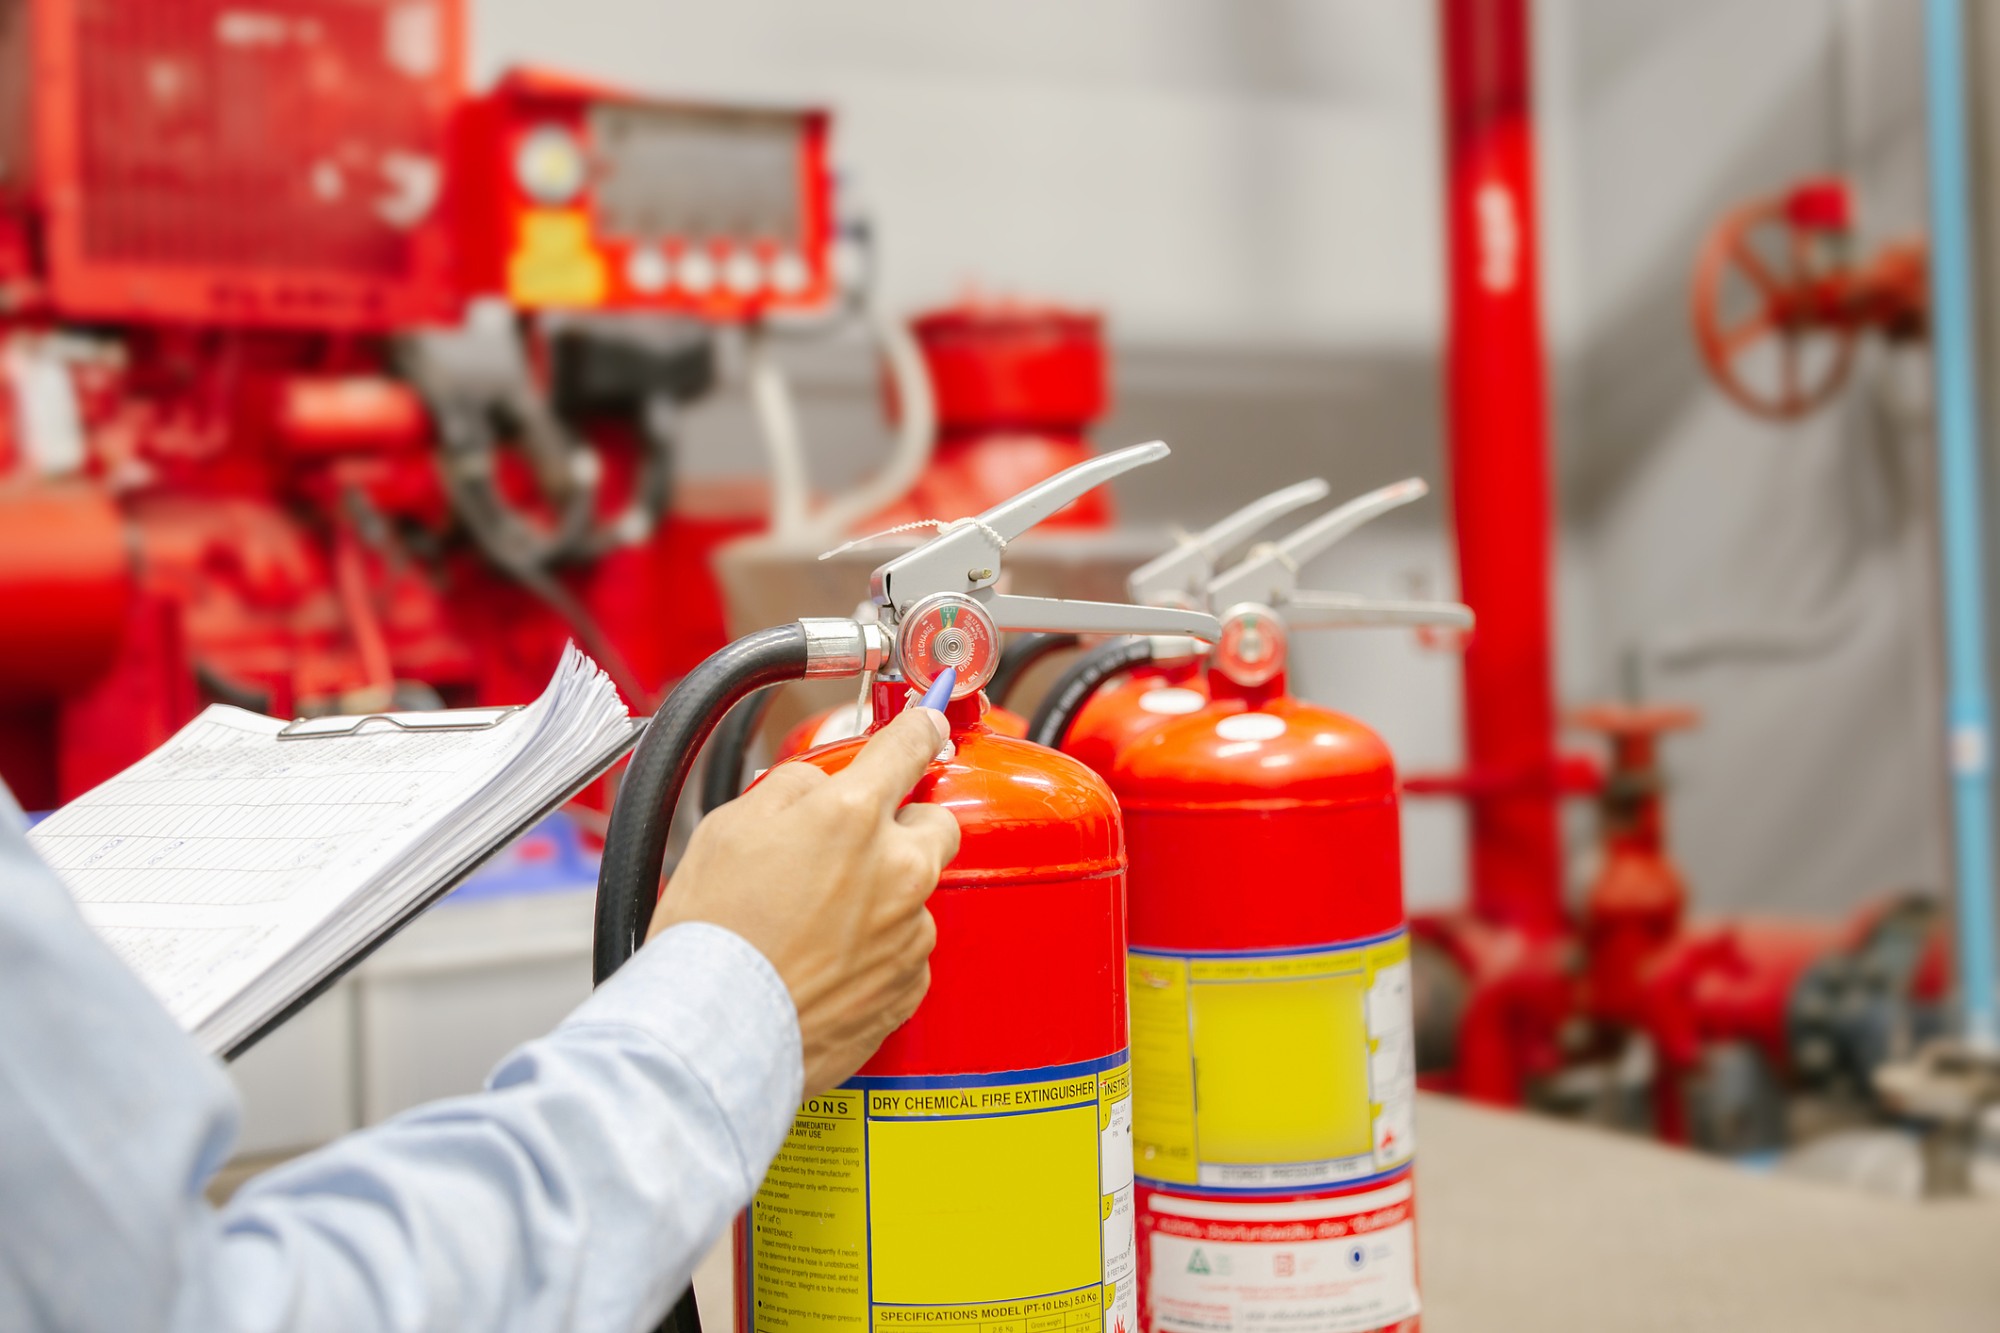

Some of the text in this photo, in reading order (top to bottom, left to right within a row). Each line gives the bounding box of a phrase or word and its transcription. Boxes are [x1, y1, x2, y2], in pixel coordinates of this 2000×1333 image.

[918, 623, 936, 656] RECHARGE
[873, 1081, 1094, 1110] DRY CHEMICAL FIRE EXTINGUISHER
[796, 1120, 836, 1131] IMMEDIATELY
[796, 1129, 807, 1138] ANY
[808, 1130, 822, 1138] USE
[826, 1146, 858, 1154] organization
[842, 1158, 860, 1167] Using
[800, 1168, 806, 1176] by
[806, 1182, 816, 1192] only
[794, 1208, 822, 1218] temperature
[762, 1226, 793, 1238] MAINTENANCE
[811, 1246, 835, 1256] frequently
[806, 1258, 817, 1266] hose
[798, 1282, 816, 1291] Weight
[836, 1286, 859, 1294] checked
[880, 1310, 978, 1322] SPECIFICATIONS
[981, 1306, 1021, 1318] MODEL
[1024, 1302, 1051, 1316] (PT-10
[1054, 1297, 1073, 1309] Lbs.)
[1075, 1295, 1086, 1305] 5.0
[788, 1309, 806, 1318] pointing
[822, 1313, 837, 1322] green
[1047, 1319, 1062, 1328] weight
